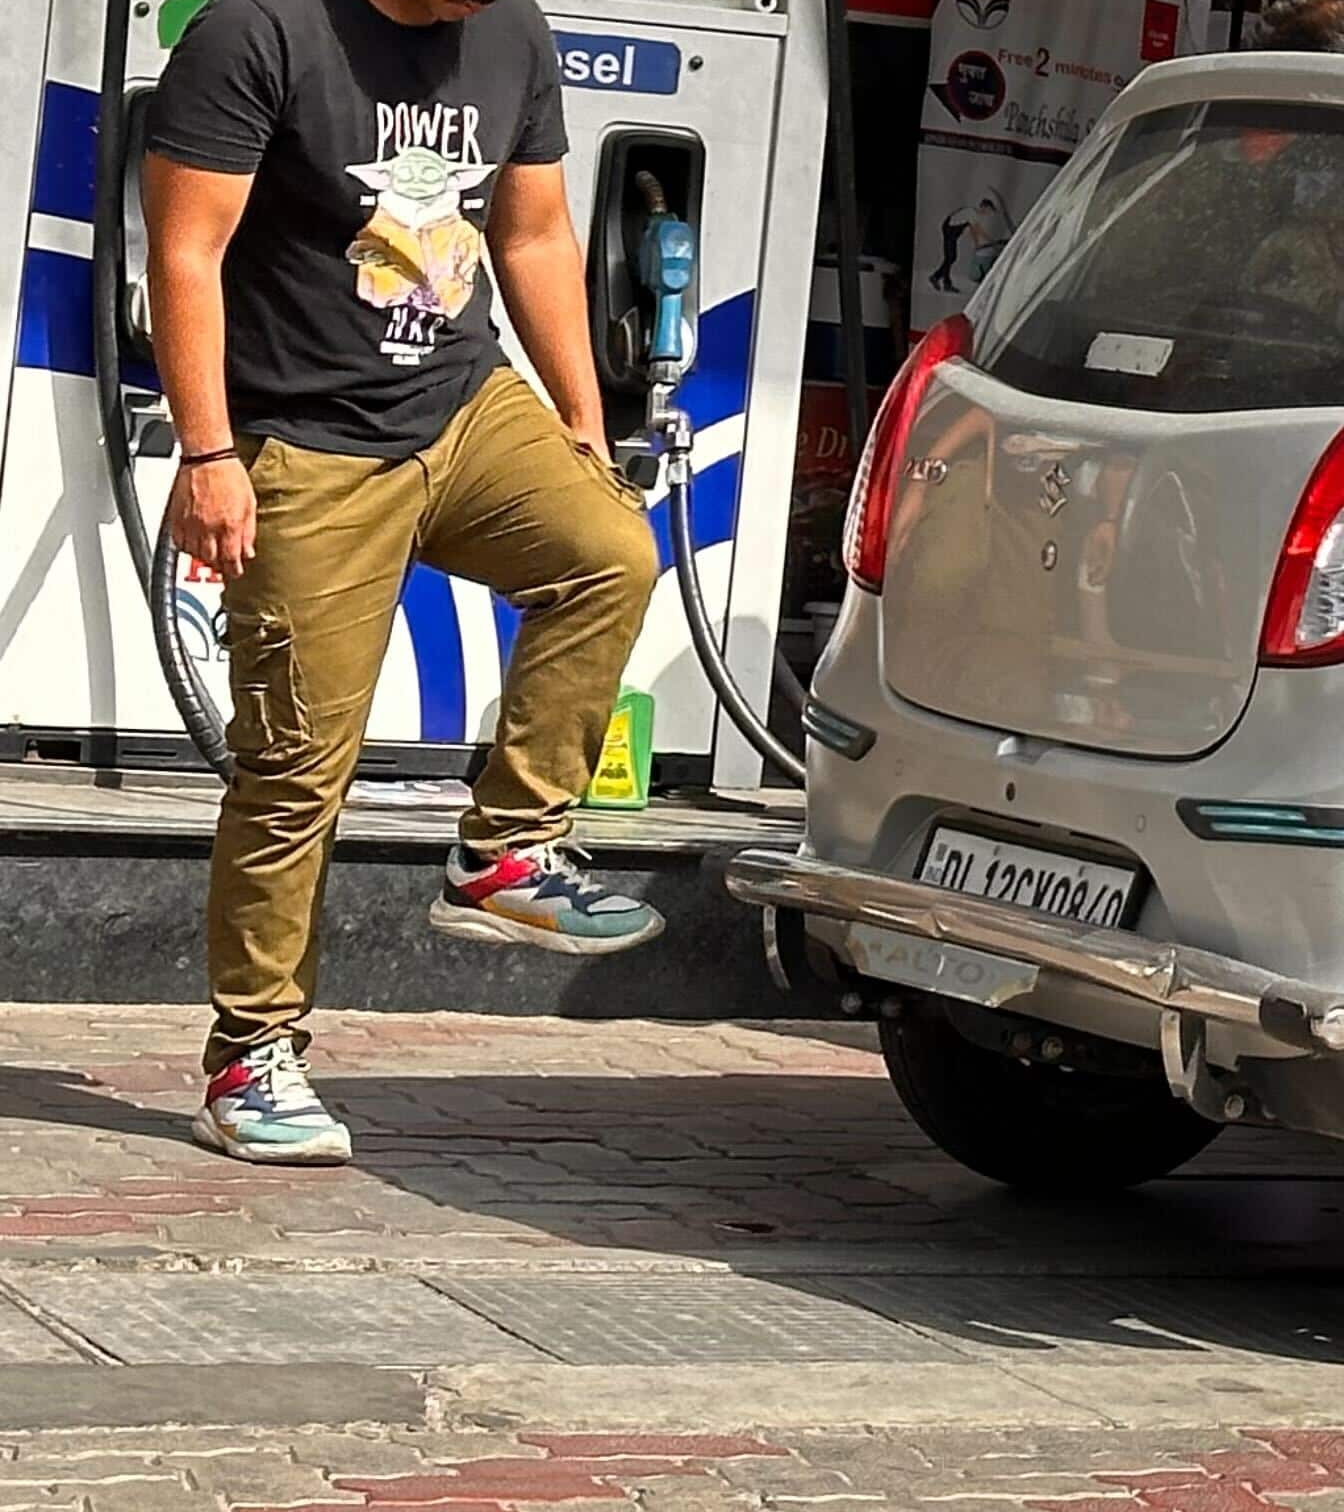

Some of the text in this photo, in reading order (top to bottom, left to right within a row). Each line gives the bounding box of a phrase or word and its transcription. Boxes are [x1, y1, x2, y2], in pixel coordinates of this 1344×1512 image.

[557, 45, 636, 86] sel
[997, 48, 1033, 68] Free
[1034, 46, 1051, 79] 2
[376, 101, 483, 166] POWER
